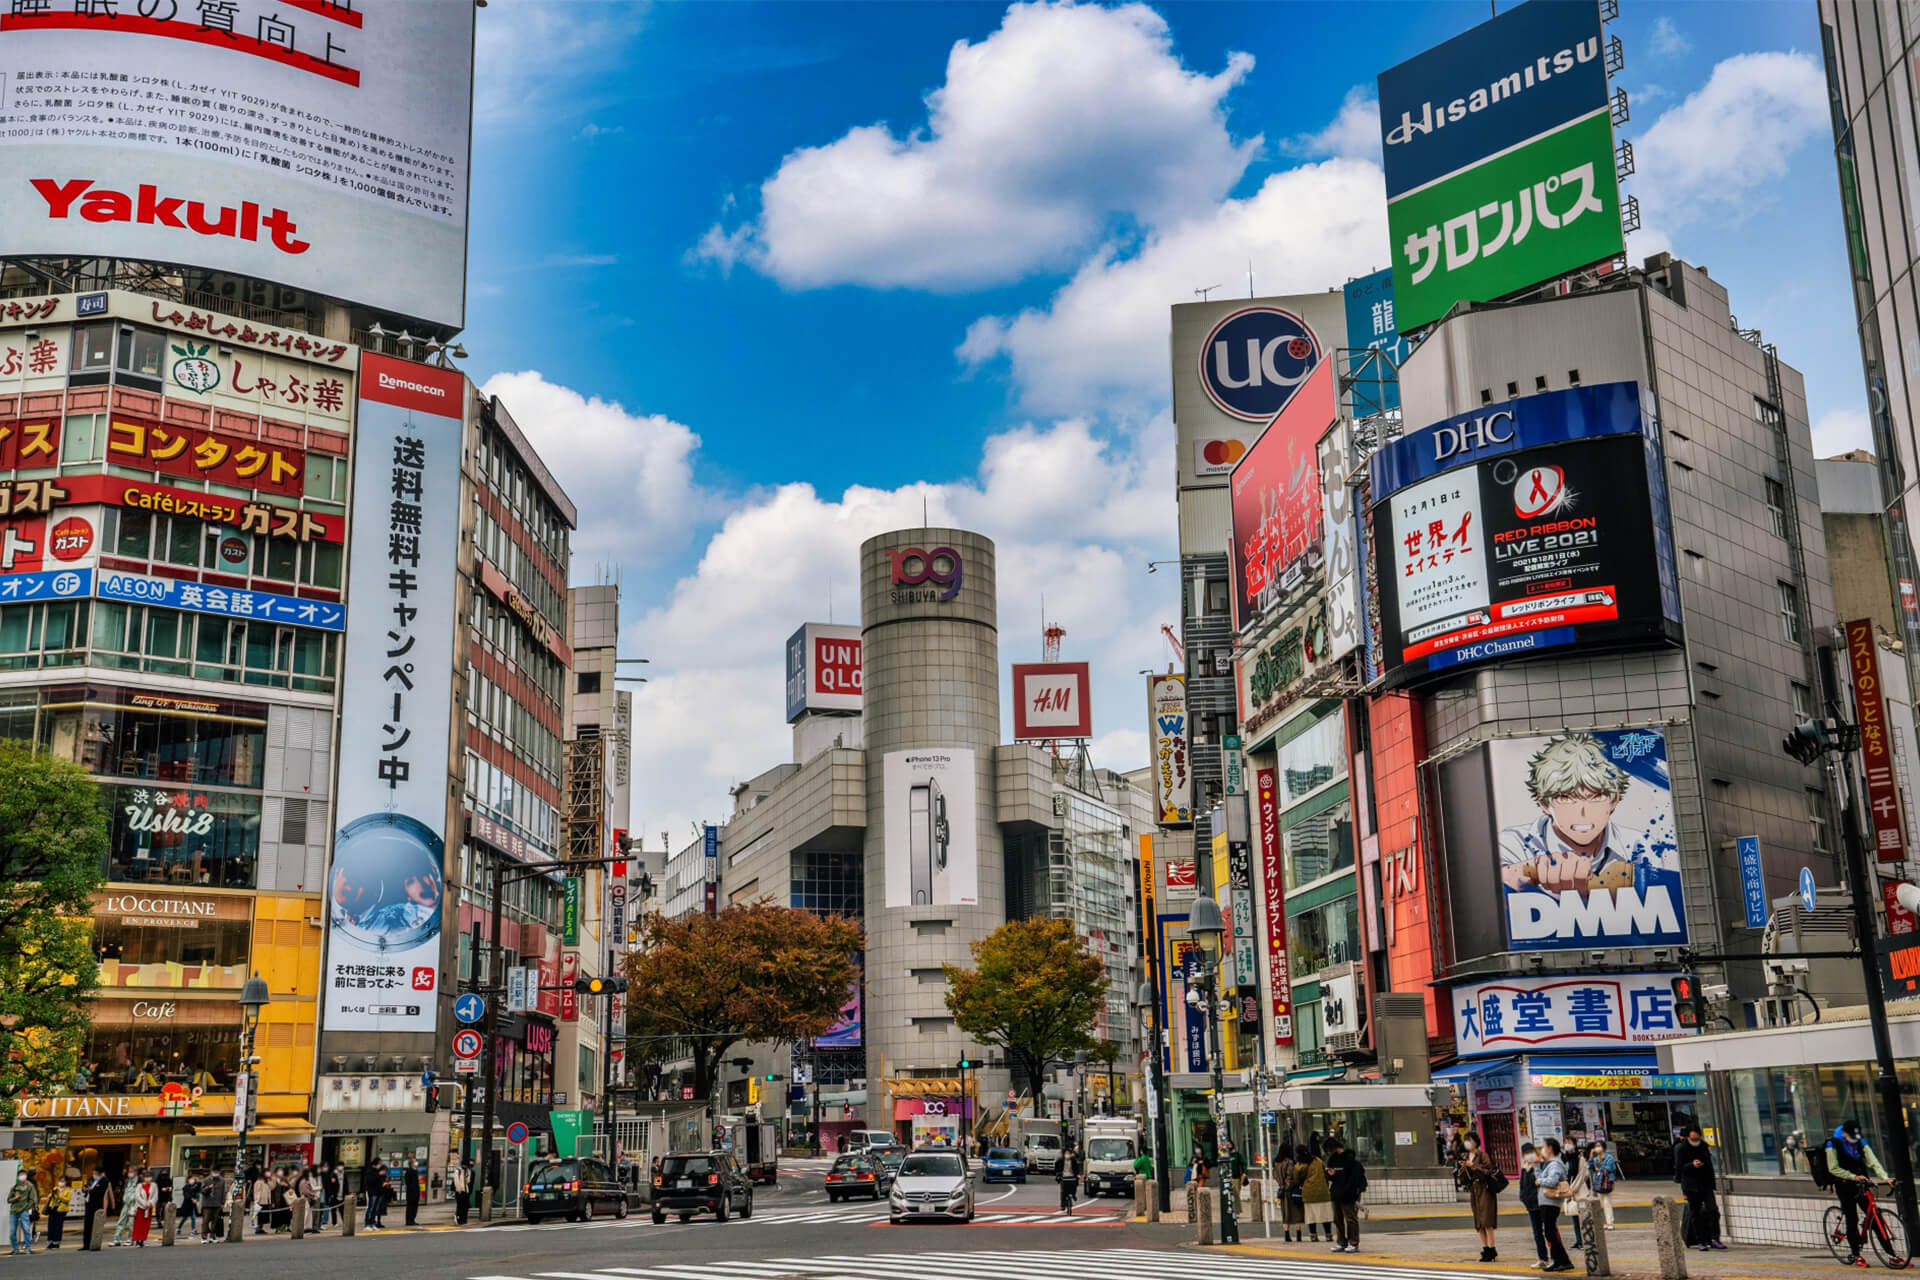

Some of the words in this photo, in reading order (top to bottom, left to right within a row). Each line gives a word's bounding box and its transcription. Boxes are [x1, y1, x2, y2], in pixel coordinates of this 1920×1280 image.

[1386, 36, 1598, 145] Hisamitsu
[30, 178, 310, 255] Yakult
[1404, 161, 1603, 286] サロンパス
[152, 301, 348, 361] しゃぶしゃぶバイキング
[1371, 299, 1395, 336] 龍
[231, 359, 344, 413] しゃぶ葉
[378, 372, 446, 397] Demaecan
[1432, 410, 1516, 462] DHC
[110, 421, 297, 484] コンタクト
[240, 503, 325, 542] ガスト
[1493, 528, 1528, 545] RED
[1530, 516, 1597, 537] RIBBON
[54, 535, 89, 550] ガスト
[223, 547, 246, 557] ガスト
[1322, 434, 1356, 645] もんじゃ
[1495, 538, 1541, 560] LIVE
[1544, 529, 1598, 550] 2021
[885, 547, 963, 600] 109
[1404, 547, 1473, 577] エイズデー
[55, 575, 77, 592] 6F
[890, 590, 937, 602] SHIBUYA
[108, 576, 166, 598] AEON
[180, 583, 341, 624] 英会話イーオン
[378, 434, 425, 789] 送料無料キャンペーン中
[1511, 596, 1576, 613] レッドリボンライブ
[821, 645, 861, 666] UNI
[1456, 645, 1482, 662] DHC
[1484, 636, 1536, 656] Channel
[821, 667, 864, 690] QLO
[1033, 687, 1072, 713] H&M
[1852, 626, 1884, 757] クスリのことなら
[1868, 766, 1902, 851] 三千里
[1262, 802, 1281, 937] ウィンターフルーツギフト
[1743, 842, 1764, 923] 大盛堂商事ビル
[107, 895, 216, 916] L'OCCITANE
[1507, 885, 1682, 941] DMM
[125, 917, 139, 925] EN
[143, 918, 196, 927] PROVENCE
[335, 964, 406, 977] それ渋谷に来る
[132, 1001, 176, 1021] Café
[1461, 987, 1674, 1041] 大盛堂書店
[526, 1023, 552, 1053] LUSH
[1191, 1025, 1201, 1066] みずほ銀行
[1632, 1034, 1655, 1042] BOOKS
[1543, 1075, 1642, 1089] ノンフィクション本大賞
